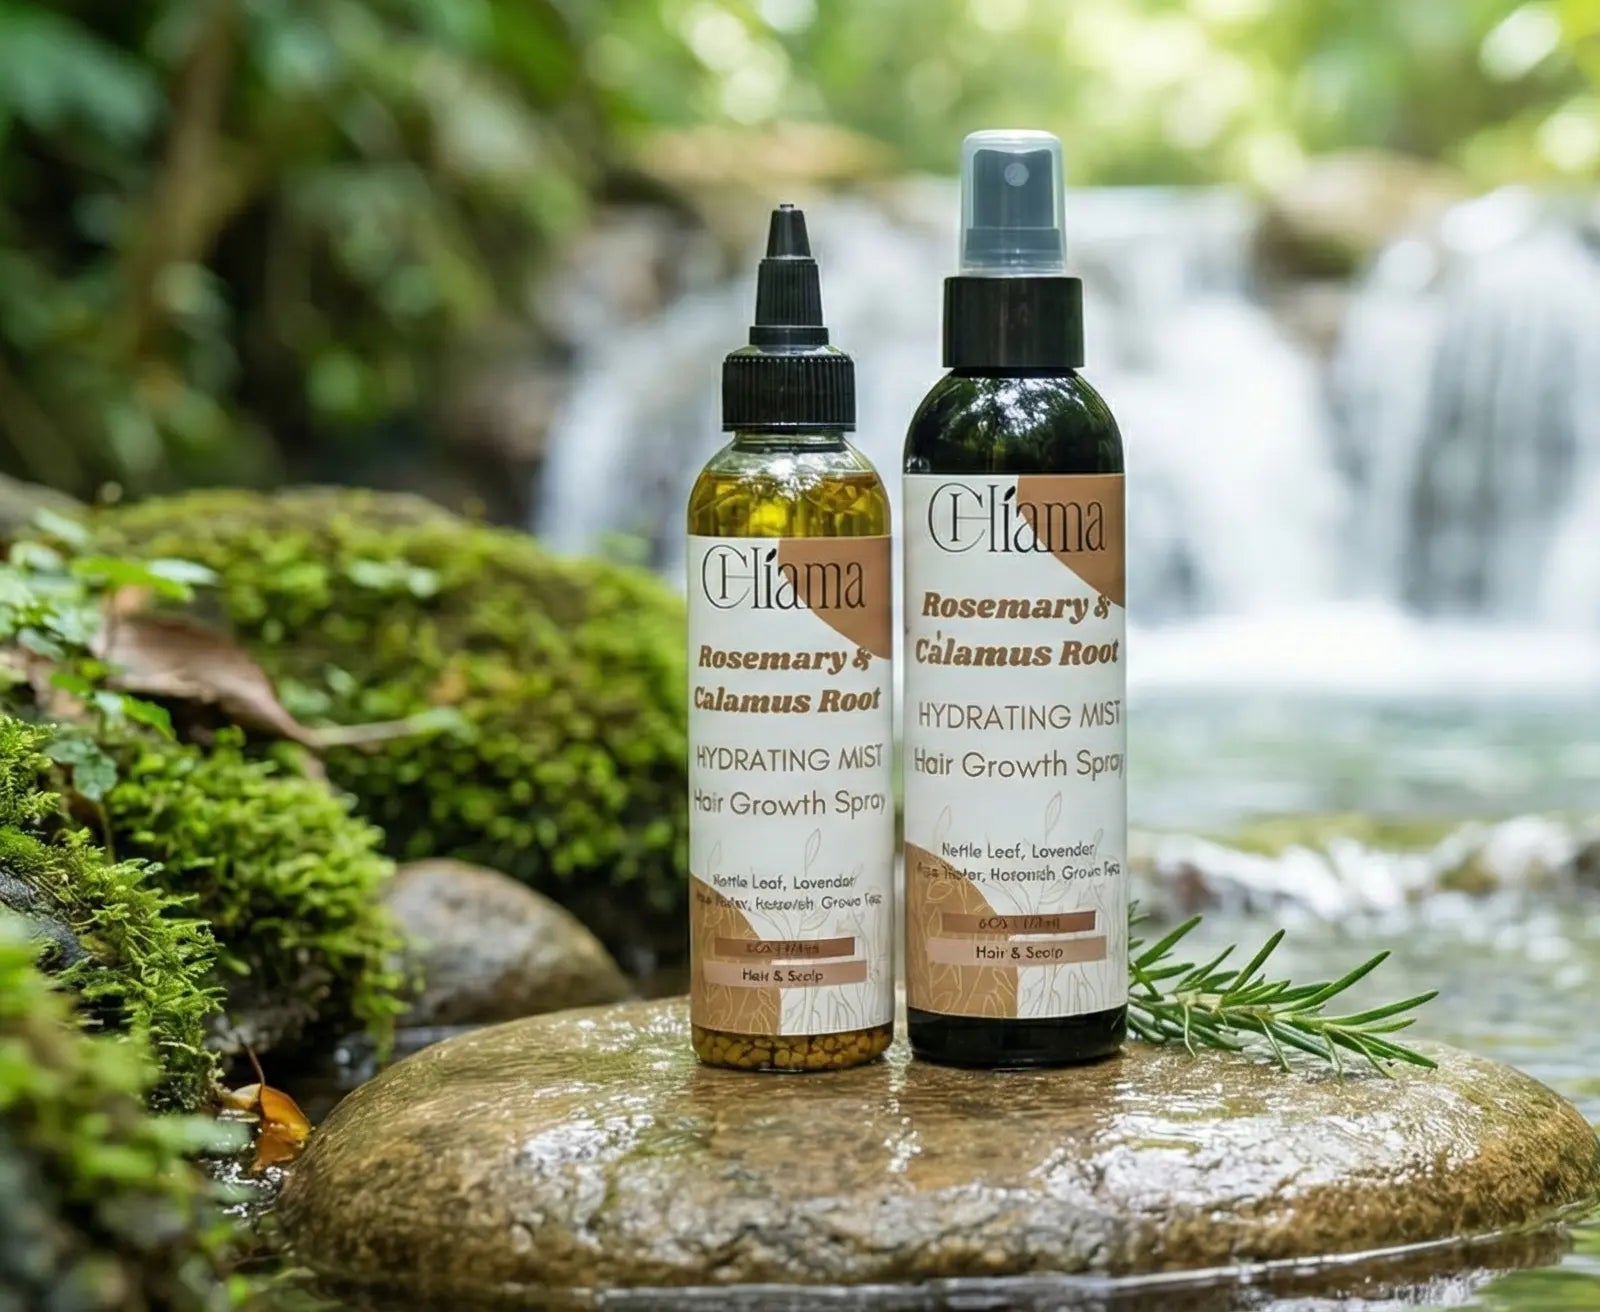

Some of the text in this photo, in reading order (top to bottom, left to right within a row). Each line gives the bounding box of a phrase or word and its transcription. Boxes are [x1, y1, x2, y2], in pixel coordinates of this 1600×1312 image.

[922, 591, 1111, 624] Rosemary &
[698, 644, 873, 676] Rosemary &
[915, 637, 1119, 667] Calamus Root
[693, 685, 882, 713] Calamus Root
[919, 700, 1121, 730] HYDRATING MIST
[696, 743, 884, 772] HYDRATING MIST
[914, 747, 1124, 782] Hair Growth Spray
[693, 787, 886, 820] Hair Growth Spray
[942, 842, 983, 859] Nettle
[1010, 946, 1021, 960] &
[772, 969, 784, 982] &
